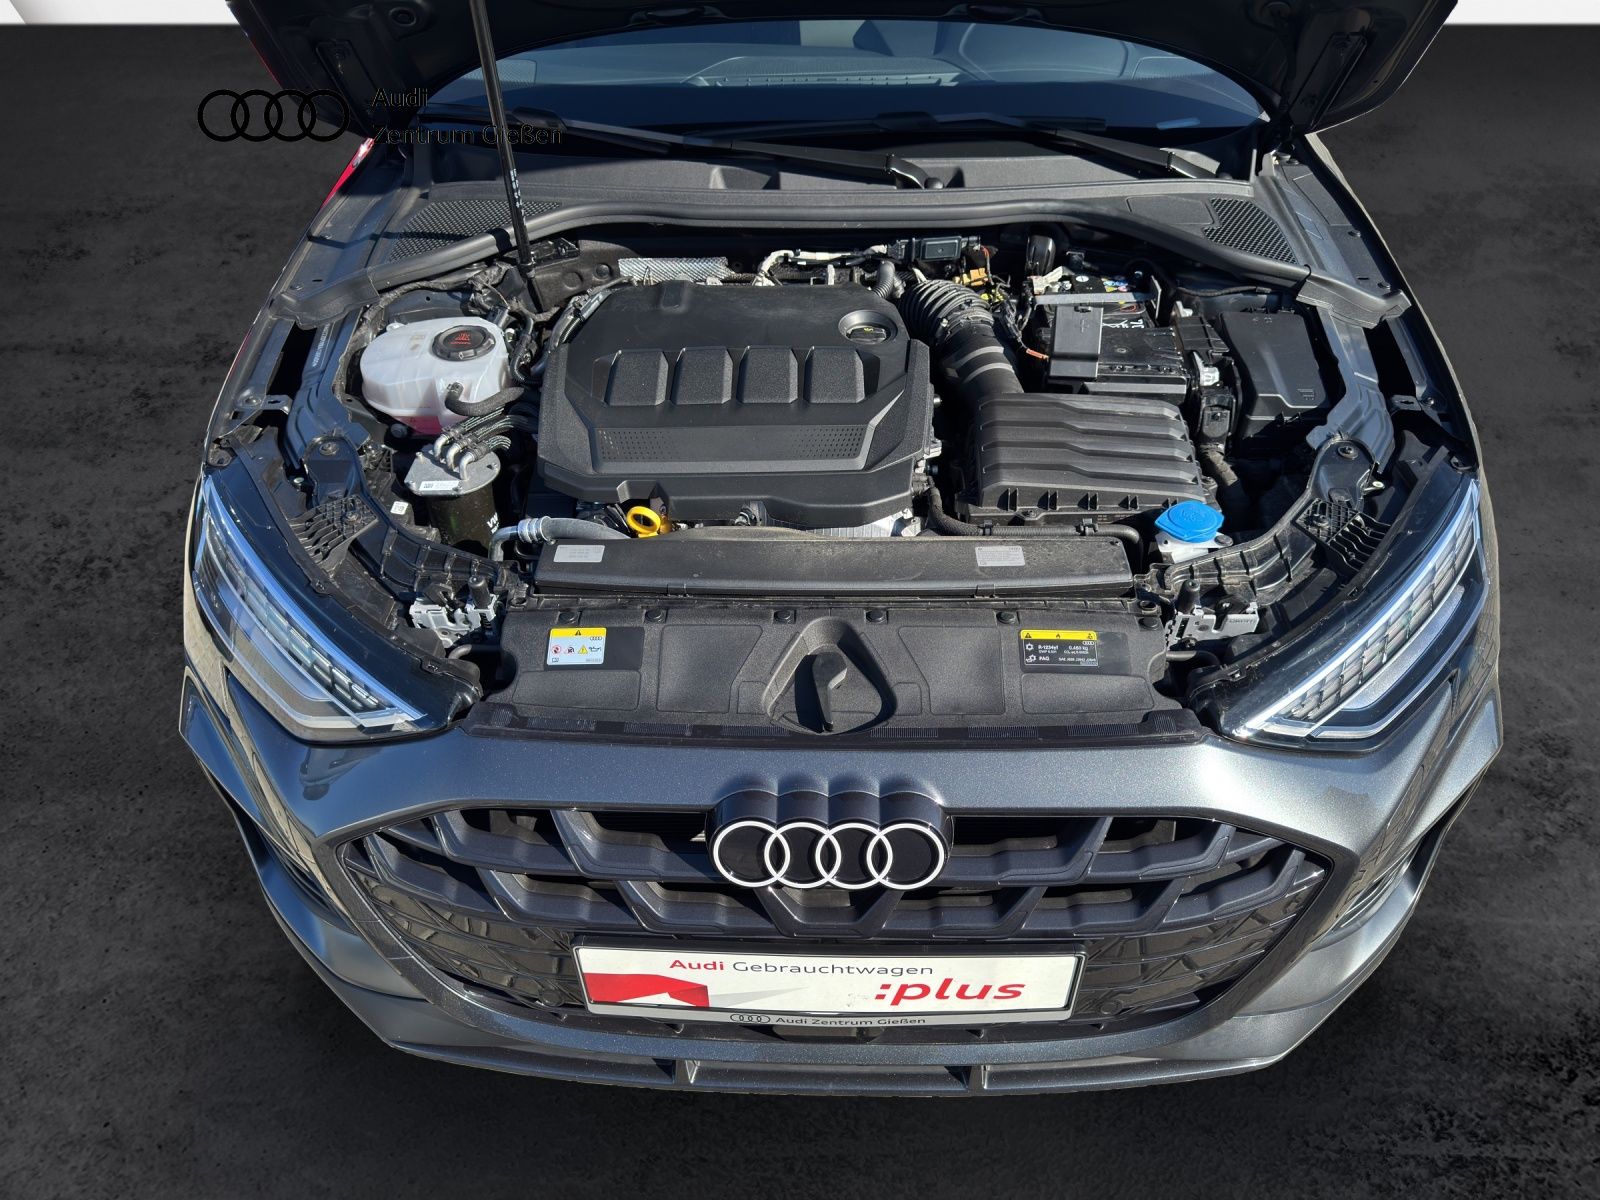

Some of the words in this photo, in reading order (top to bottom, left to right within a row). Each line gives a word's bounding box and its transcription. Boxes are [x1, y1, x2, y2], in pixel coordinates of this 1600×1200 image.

[669, 959, 725, 971] Audi
[732, 961, 933, 977] Gebrauchtwagen
[775, 1017, 807, 1025] Audi
[811, 1018, 873, 1026] Zentrum
